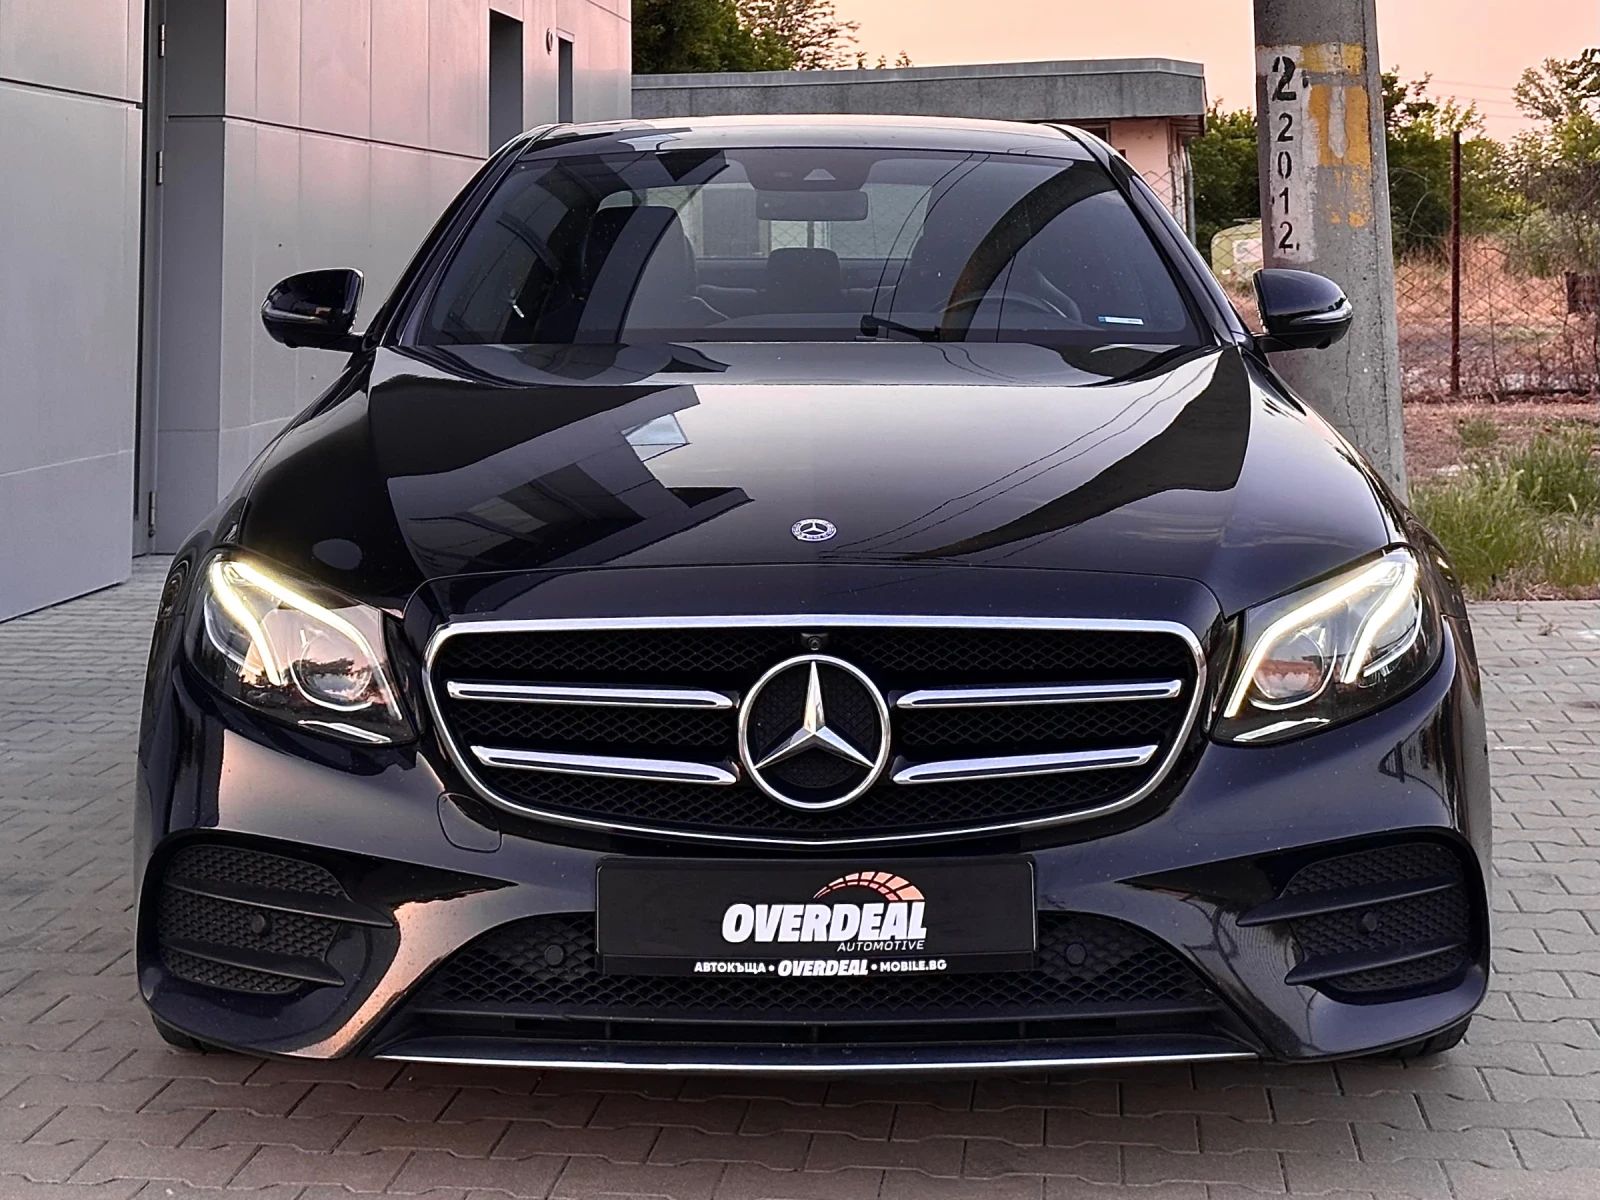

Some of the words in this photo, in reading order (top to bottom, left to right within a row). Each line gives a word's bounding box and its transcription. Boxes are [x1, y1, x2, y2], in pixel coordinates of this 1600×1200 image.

[721, 901, 928, 943] OVERDEAL
[836, 940, 925, 952] AUTOMOTIVE
[693, 961, 767, 975] АВТОКЪЩА
[777, 959, 869, 977] OVERDEAL
[879, 959, 948, 973] MOBILE.BG
